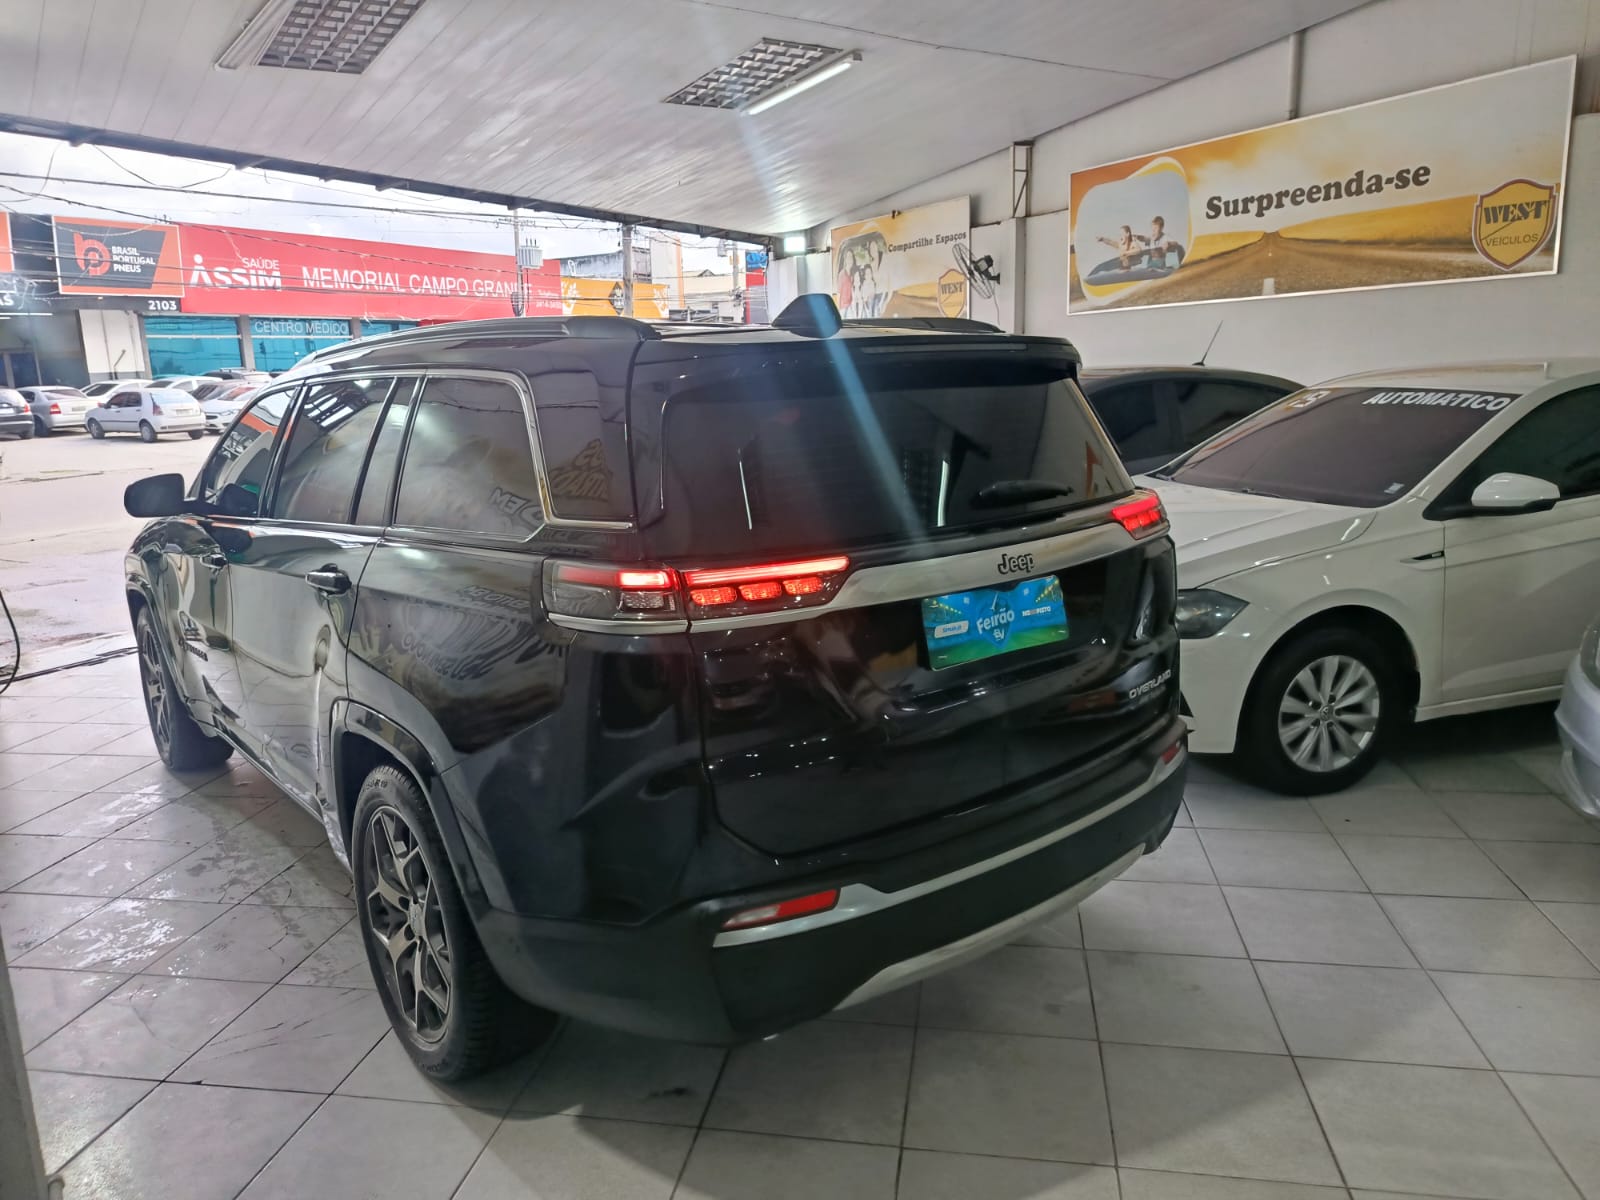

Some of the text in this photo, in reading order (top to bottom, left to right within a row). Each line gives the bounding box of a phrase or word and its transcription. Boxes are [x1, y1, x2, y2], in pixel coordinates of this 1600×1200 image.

[1204, 164, 1431, 220] Surpreenda-se
[1484, 200, 1550, 225] WEST
[111, 245, 140, 256] BRASIL
[887, 231, 967, 253] Compartilhe Espaços
[112, 255, 156, 265] PORTUGAL
[113, 264, 142, 273] PNEUS
[241, 256, 280, 270] SAÚDE
[302, 266, 403, 292] MEMORIAL
[409, 274, 469, 297] CAMPO
[147, 300, 177, 311] 2103
[254, 321, 304, 334] CENTRO
[1362, 391, 1511, 411] AUTOMATICO
[997, 553, 1035, 575] Jeep
[976, 607, 1016, 635] Feirão
